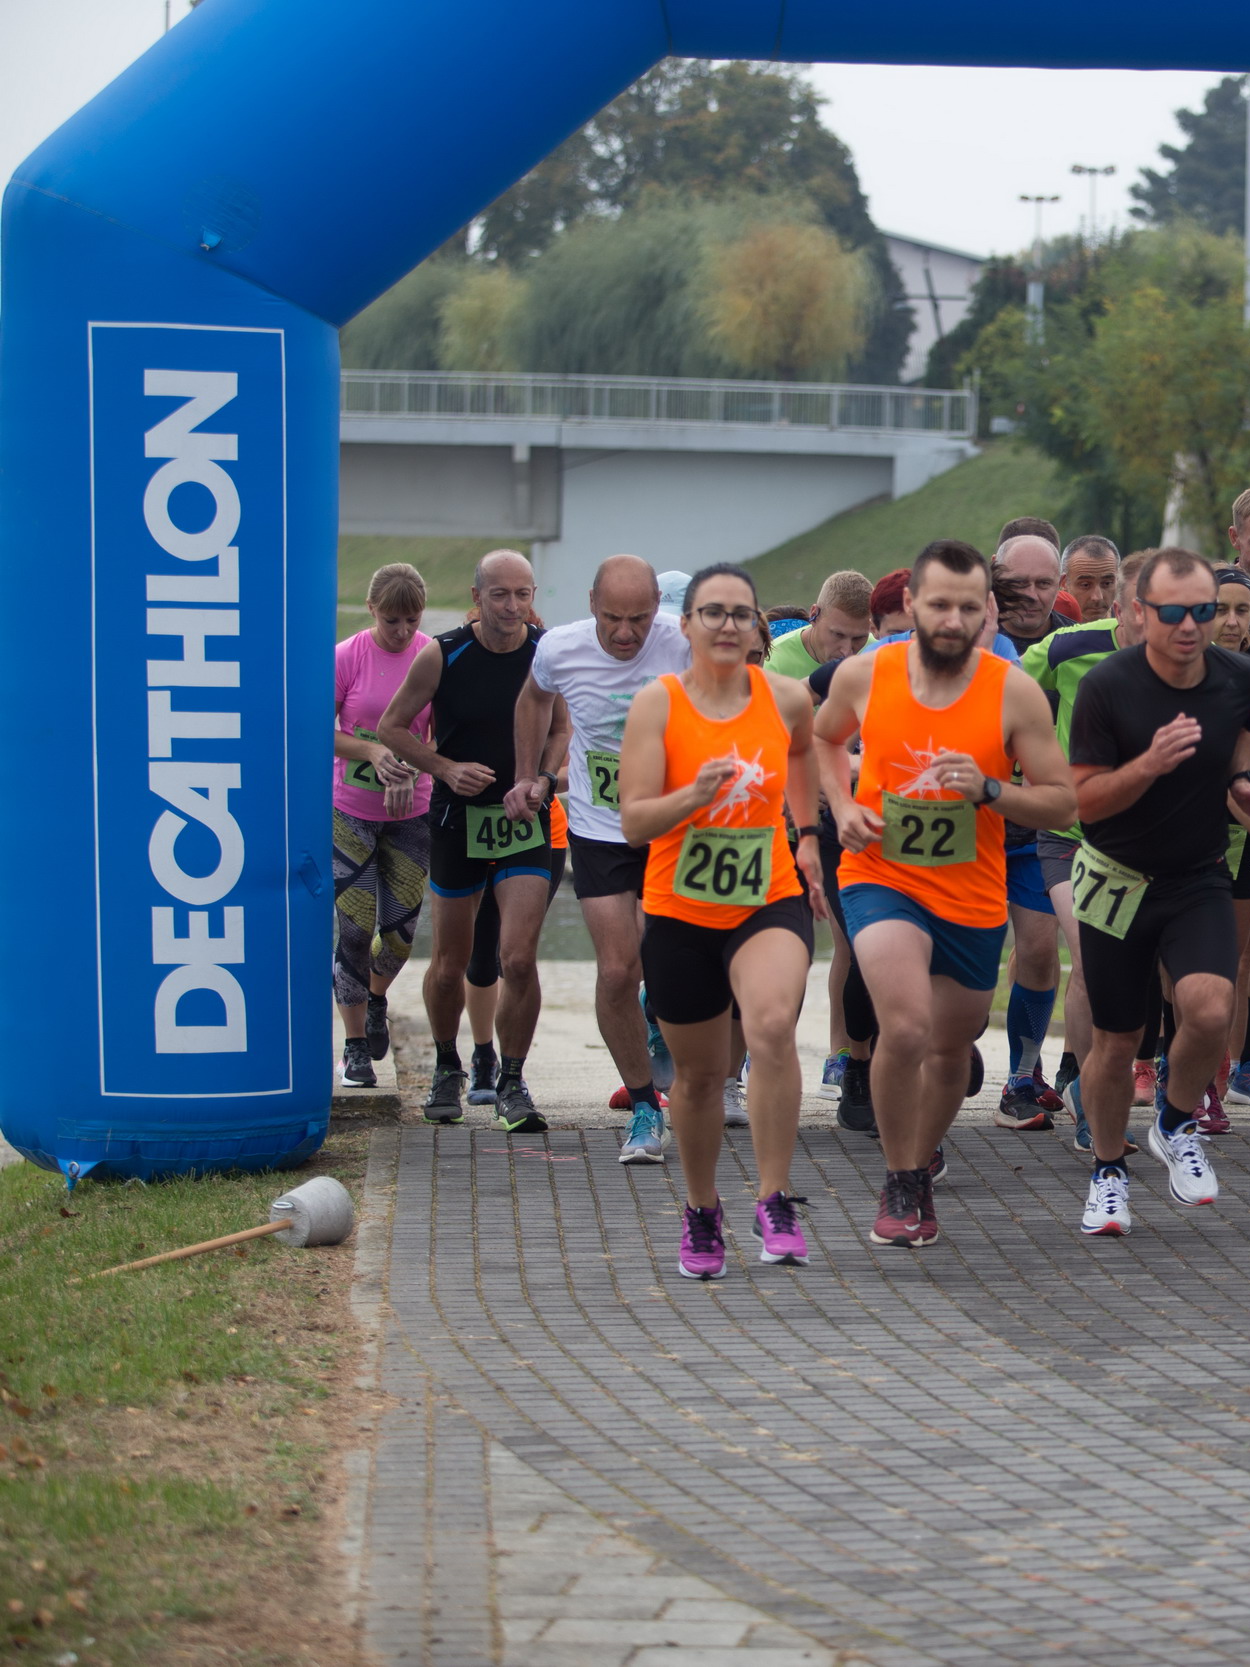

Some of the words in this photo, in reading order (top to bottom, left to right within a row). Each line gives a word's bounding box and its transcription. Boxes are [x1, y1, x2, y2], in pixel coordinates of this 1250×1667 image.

[143, 368, 248, 1054] DECATHLON
[900, 814, 955, 857] 22
[684, 842, 763, 897] 264
[1072, 860, 1129, 928] 271
